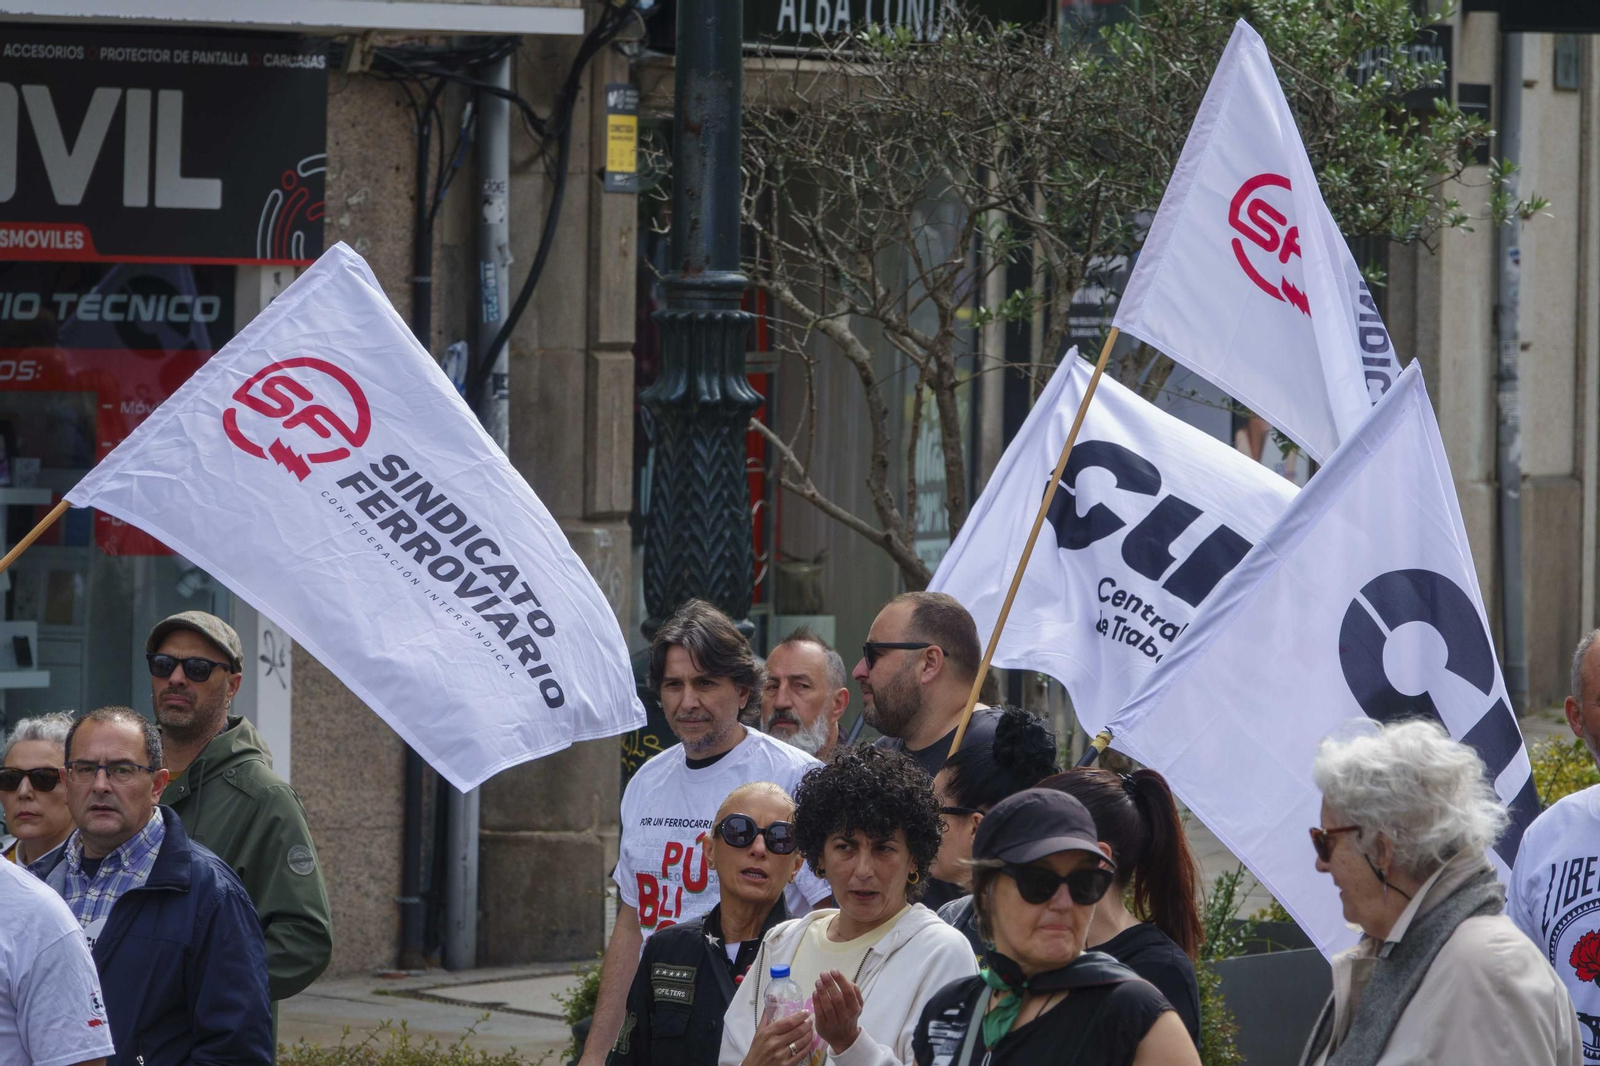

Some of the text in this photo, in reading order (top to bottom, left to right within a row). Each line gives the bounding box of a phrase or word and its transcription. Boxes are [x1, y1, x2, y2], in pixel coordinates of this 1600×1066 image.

[3, 43, 326, 70] ACCESORIOS PROTECTOR DE PANTALLA CARCASAS
[0, 286, 220, 322] IO TÉCNICO
[320, 489, 515, 679] CONFEDERACIÓN INTERSINDICAL
[369, 453, 556, 638] SINDICATO
[336, 470, 566, 709] FERROVIARIO
[640, 818, 713, 829] POR UN FERROCARRI
[1542, 856, 1600, 941] LIBE
